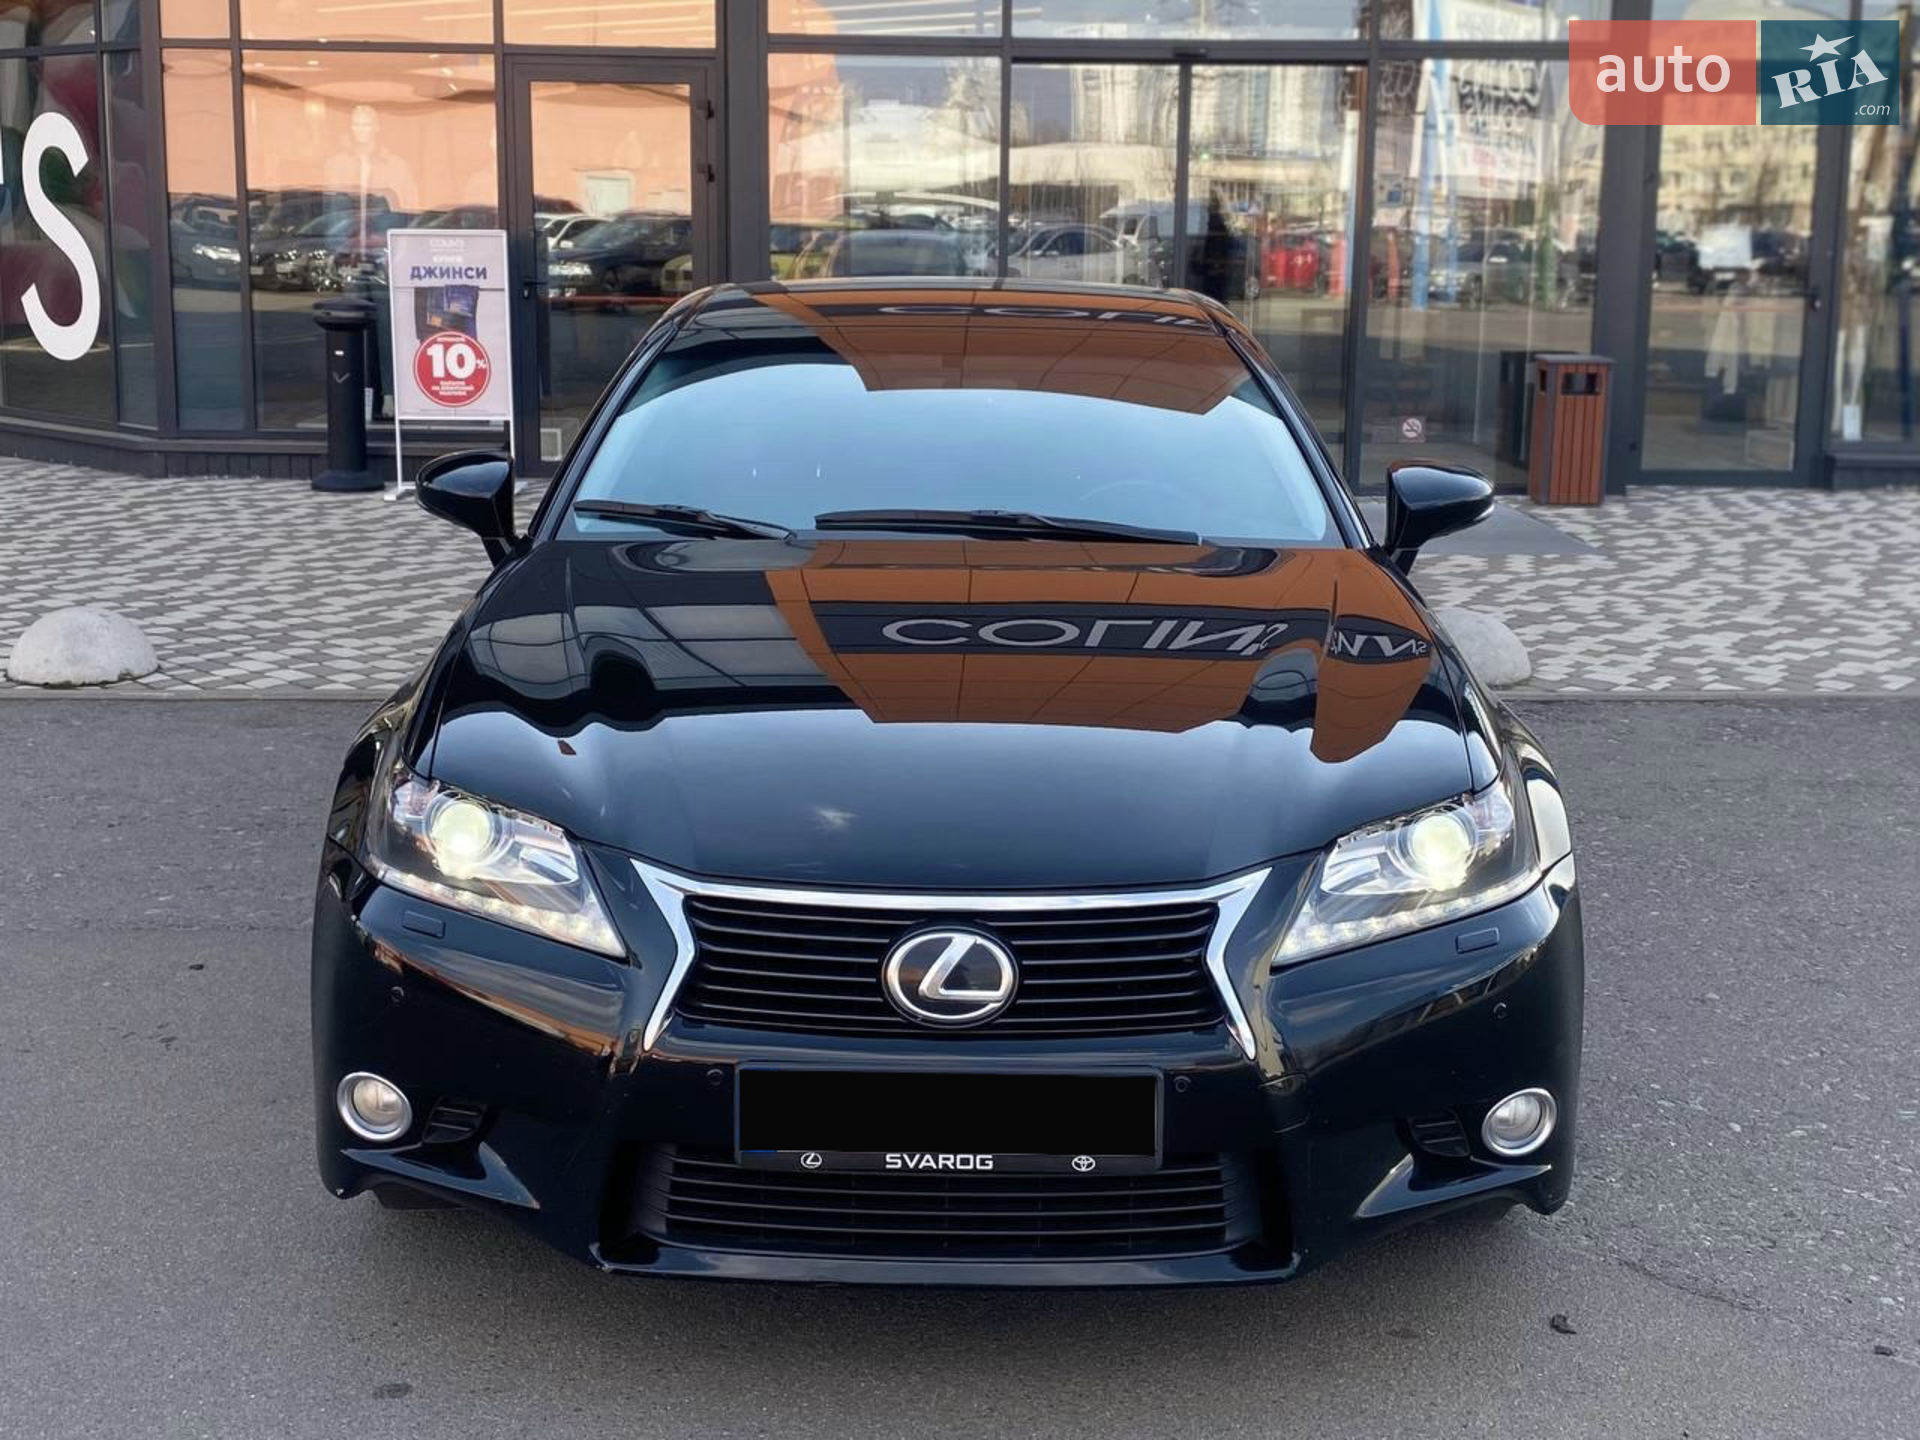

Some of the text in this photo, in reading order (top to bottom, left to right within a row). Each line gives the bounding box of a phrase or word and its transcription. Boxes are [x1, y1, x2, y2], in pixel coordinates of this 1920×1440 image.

[0, 112, 101, 361] S
[409, 265, 488, 281] ДЖИНСИ
[885, 1153, 994, 1170] SVAROG
